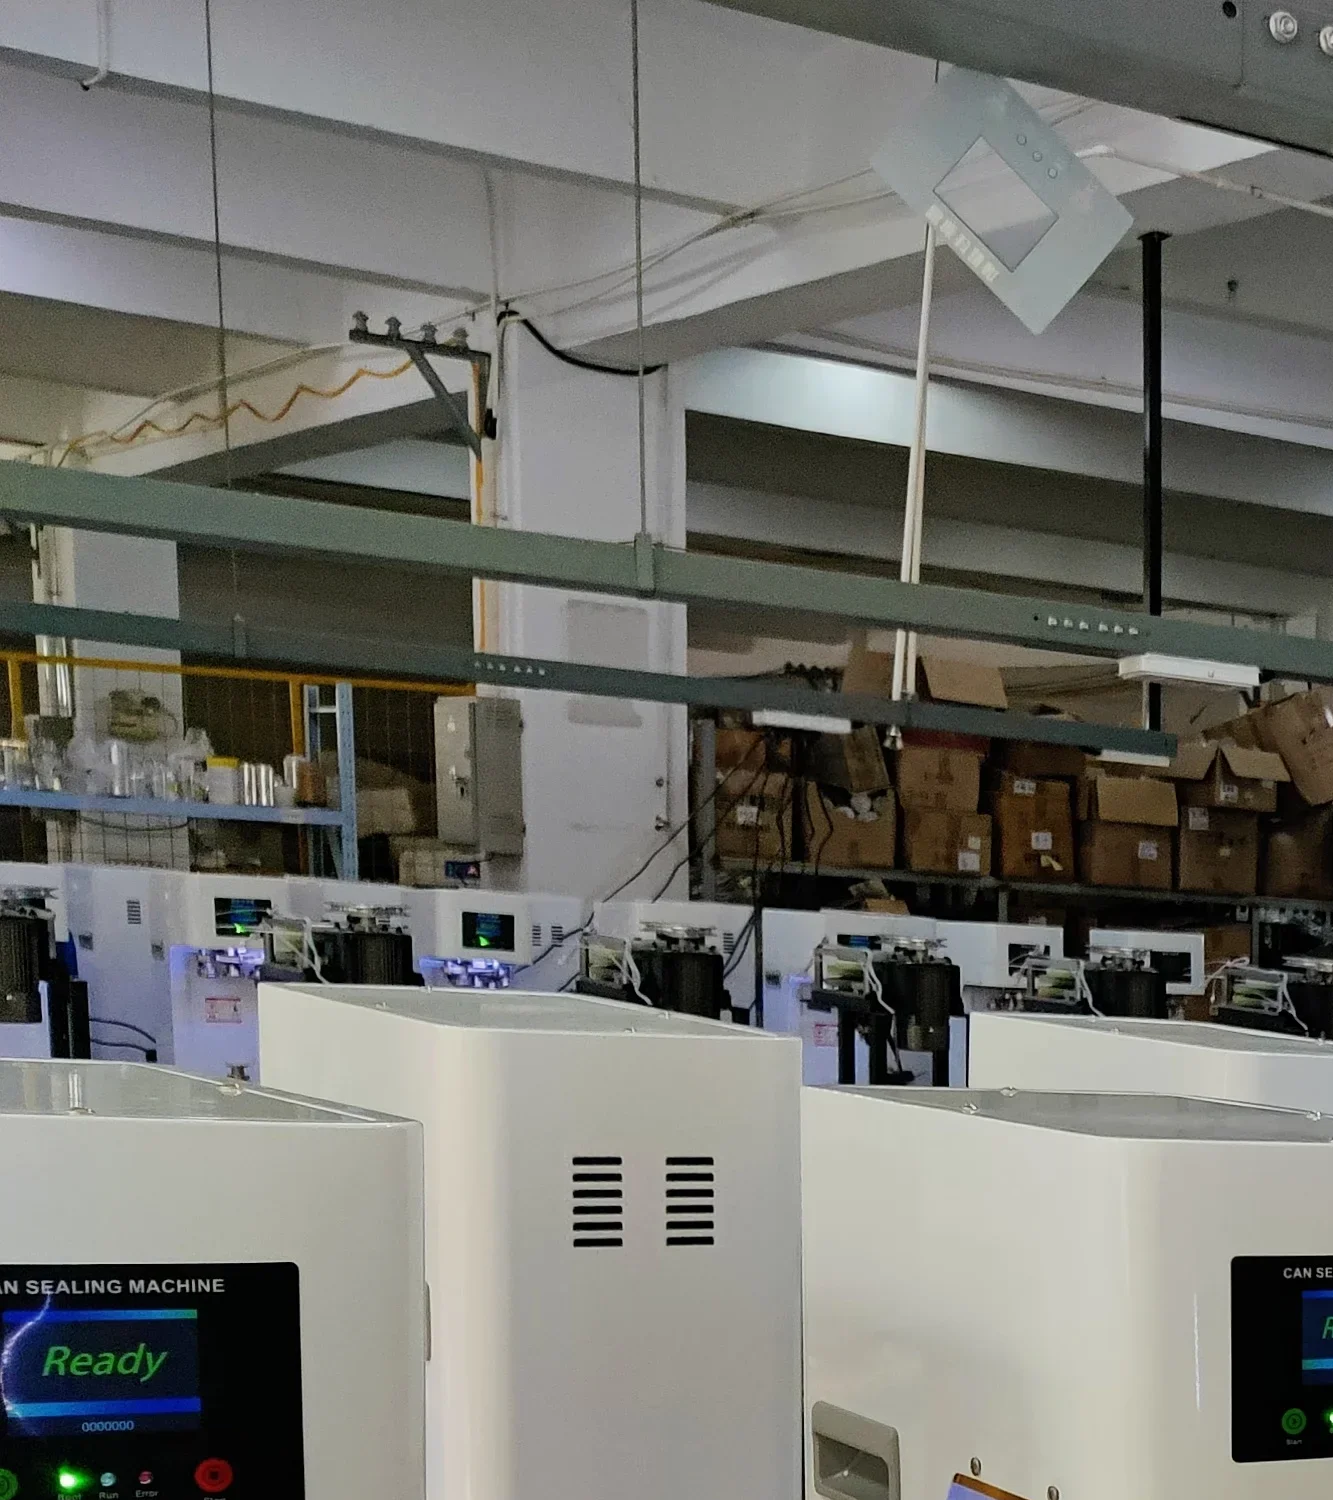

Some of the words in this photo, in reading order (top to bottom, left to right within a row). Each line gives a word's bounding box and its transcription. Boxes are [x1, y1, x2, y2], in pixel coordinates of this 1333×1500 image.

[1283, 1267, 1312, 1279] CAN
[25, 1279, 122, 1295] SEALING
[129, 1278, 225, 1294] MACHINE
[42, 1343, 168, 1382] Ready
[82, 1420, 135, 1432] 0000000
[99, 1491, 119, 1499] Run
[135, 1489, 159, 1498] Error
